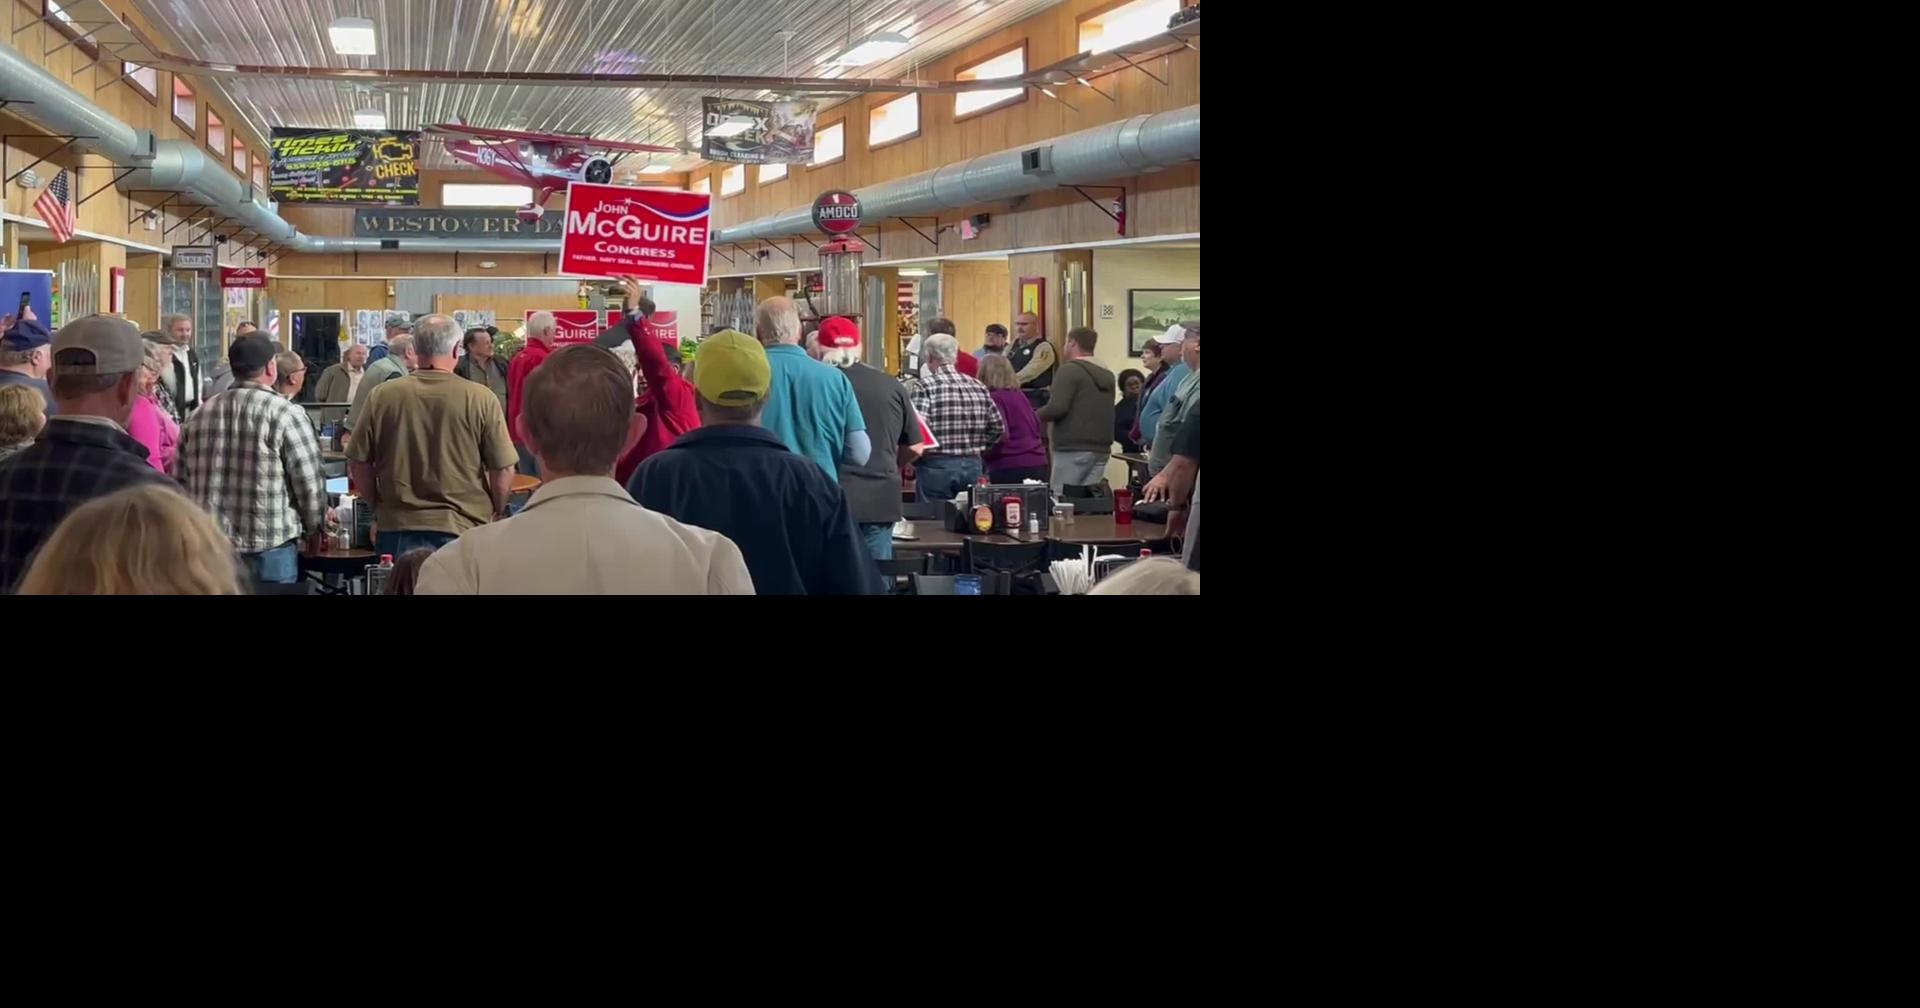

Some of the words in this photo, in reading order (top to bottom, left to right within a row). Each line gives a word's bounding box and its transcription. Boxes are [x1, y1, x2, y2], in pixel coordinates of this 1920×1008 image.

[273, 135, 349, 147] TIMES
[375, 162, 416, 179] CHECK
[594, 200, 628, 215] JOHN
[819, 206, 858, 218] AMOCO
[362, 216, 520, 232] WESTOVER
[534, 217, 564, 233] DA
[594, 241, 676, 259] CONGRESS
[637, 260, 669, 268] BUSINESS
[555, 326, 597, 339] GUIRE
